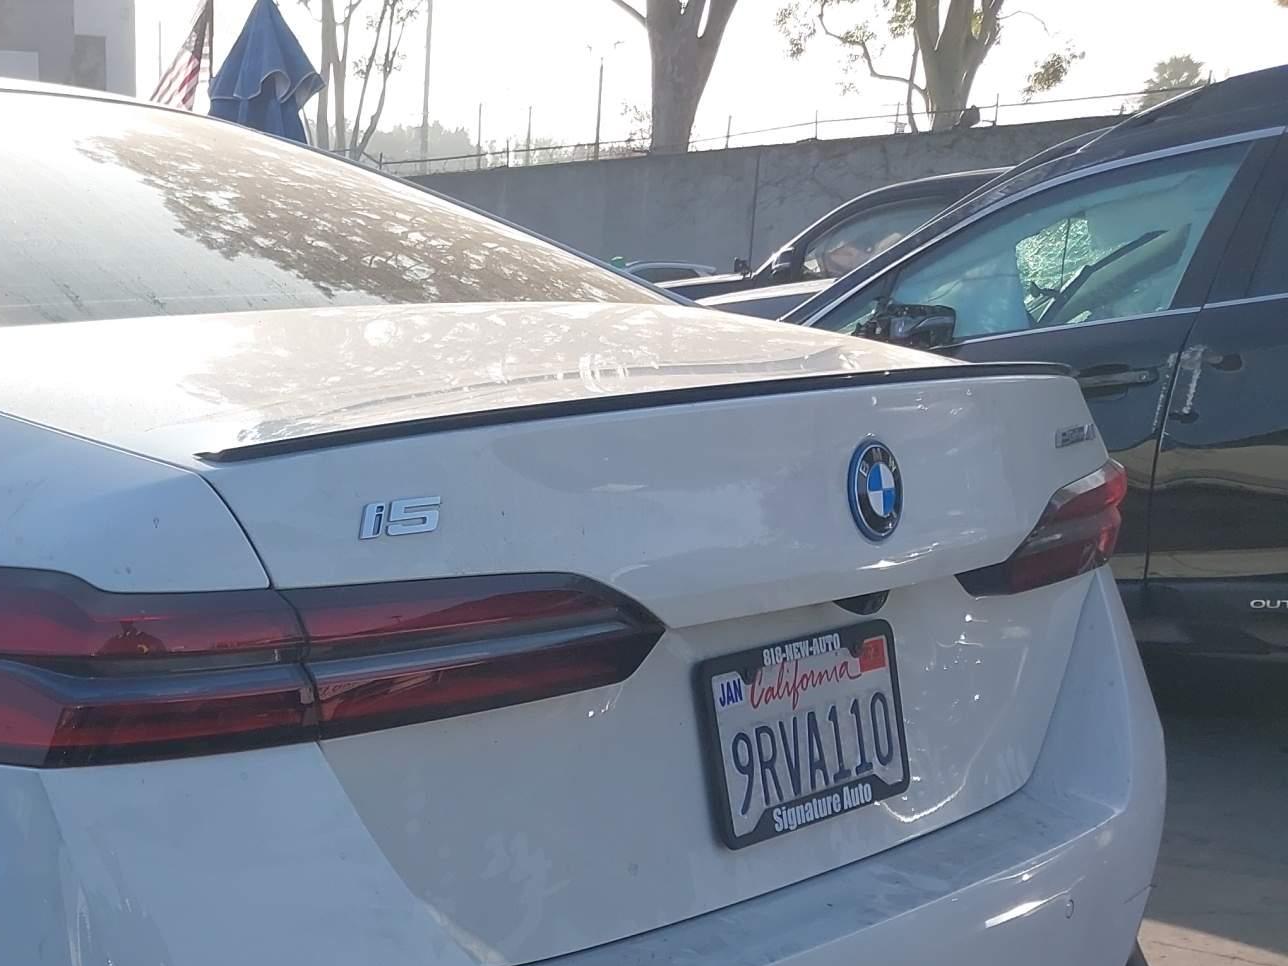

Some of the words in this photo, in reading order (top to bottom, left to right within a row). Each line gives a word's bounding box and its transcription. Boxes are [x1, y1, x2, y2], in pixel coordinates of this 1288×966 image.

[859, 447, 897, 477] BMW
[358, 496, 441, 540] i5
[762, 632, 841, 667] 818-NEW-AUTO
[718, 678, 744, 708] JAN
[749, 657, 862, 710] California
[731, 691, 894, 816] 9RVA110
[772, 793, 842, 833] Signature
[842, 782, 873, 810] Auto
